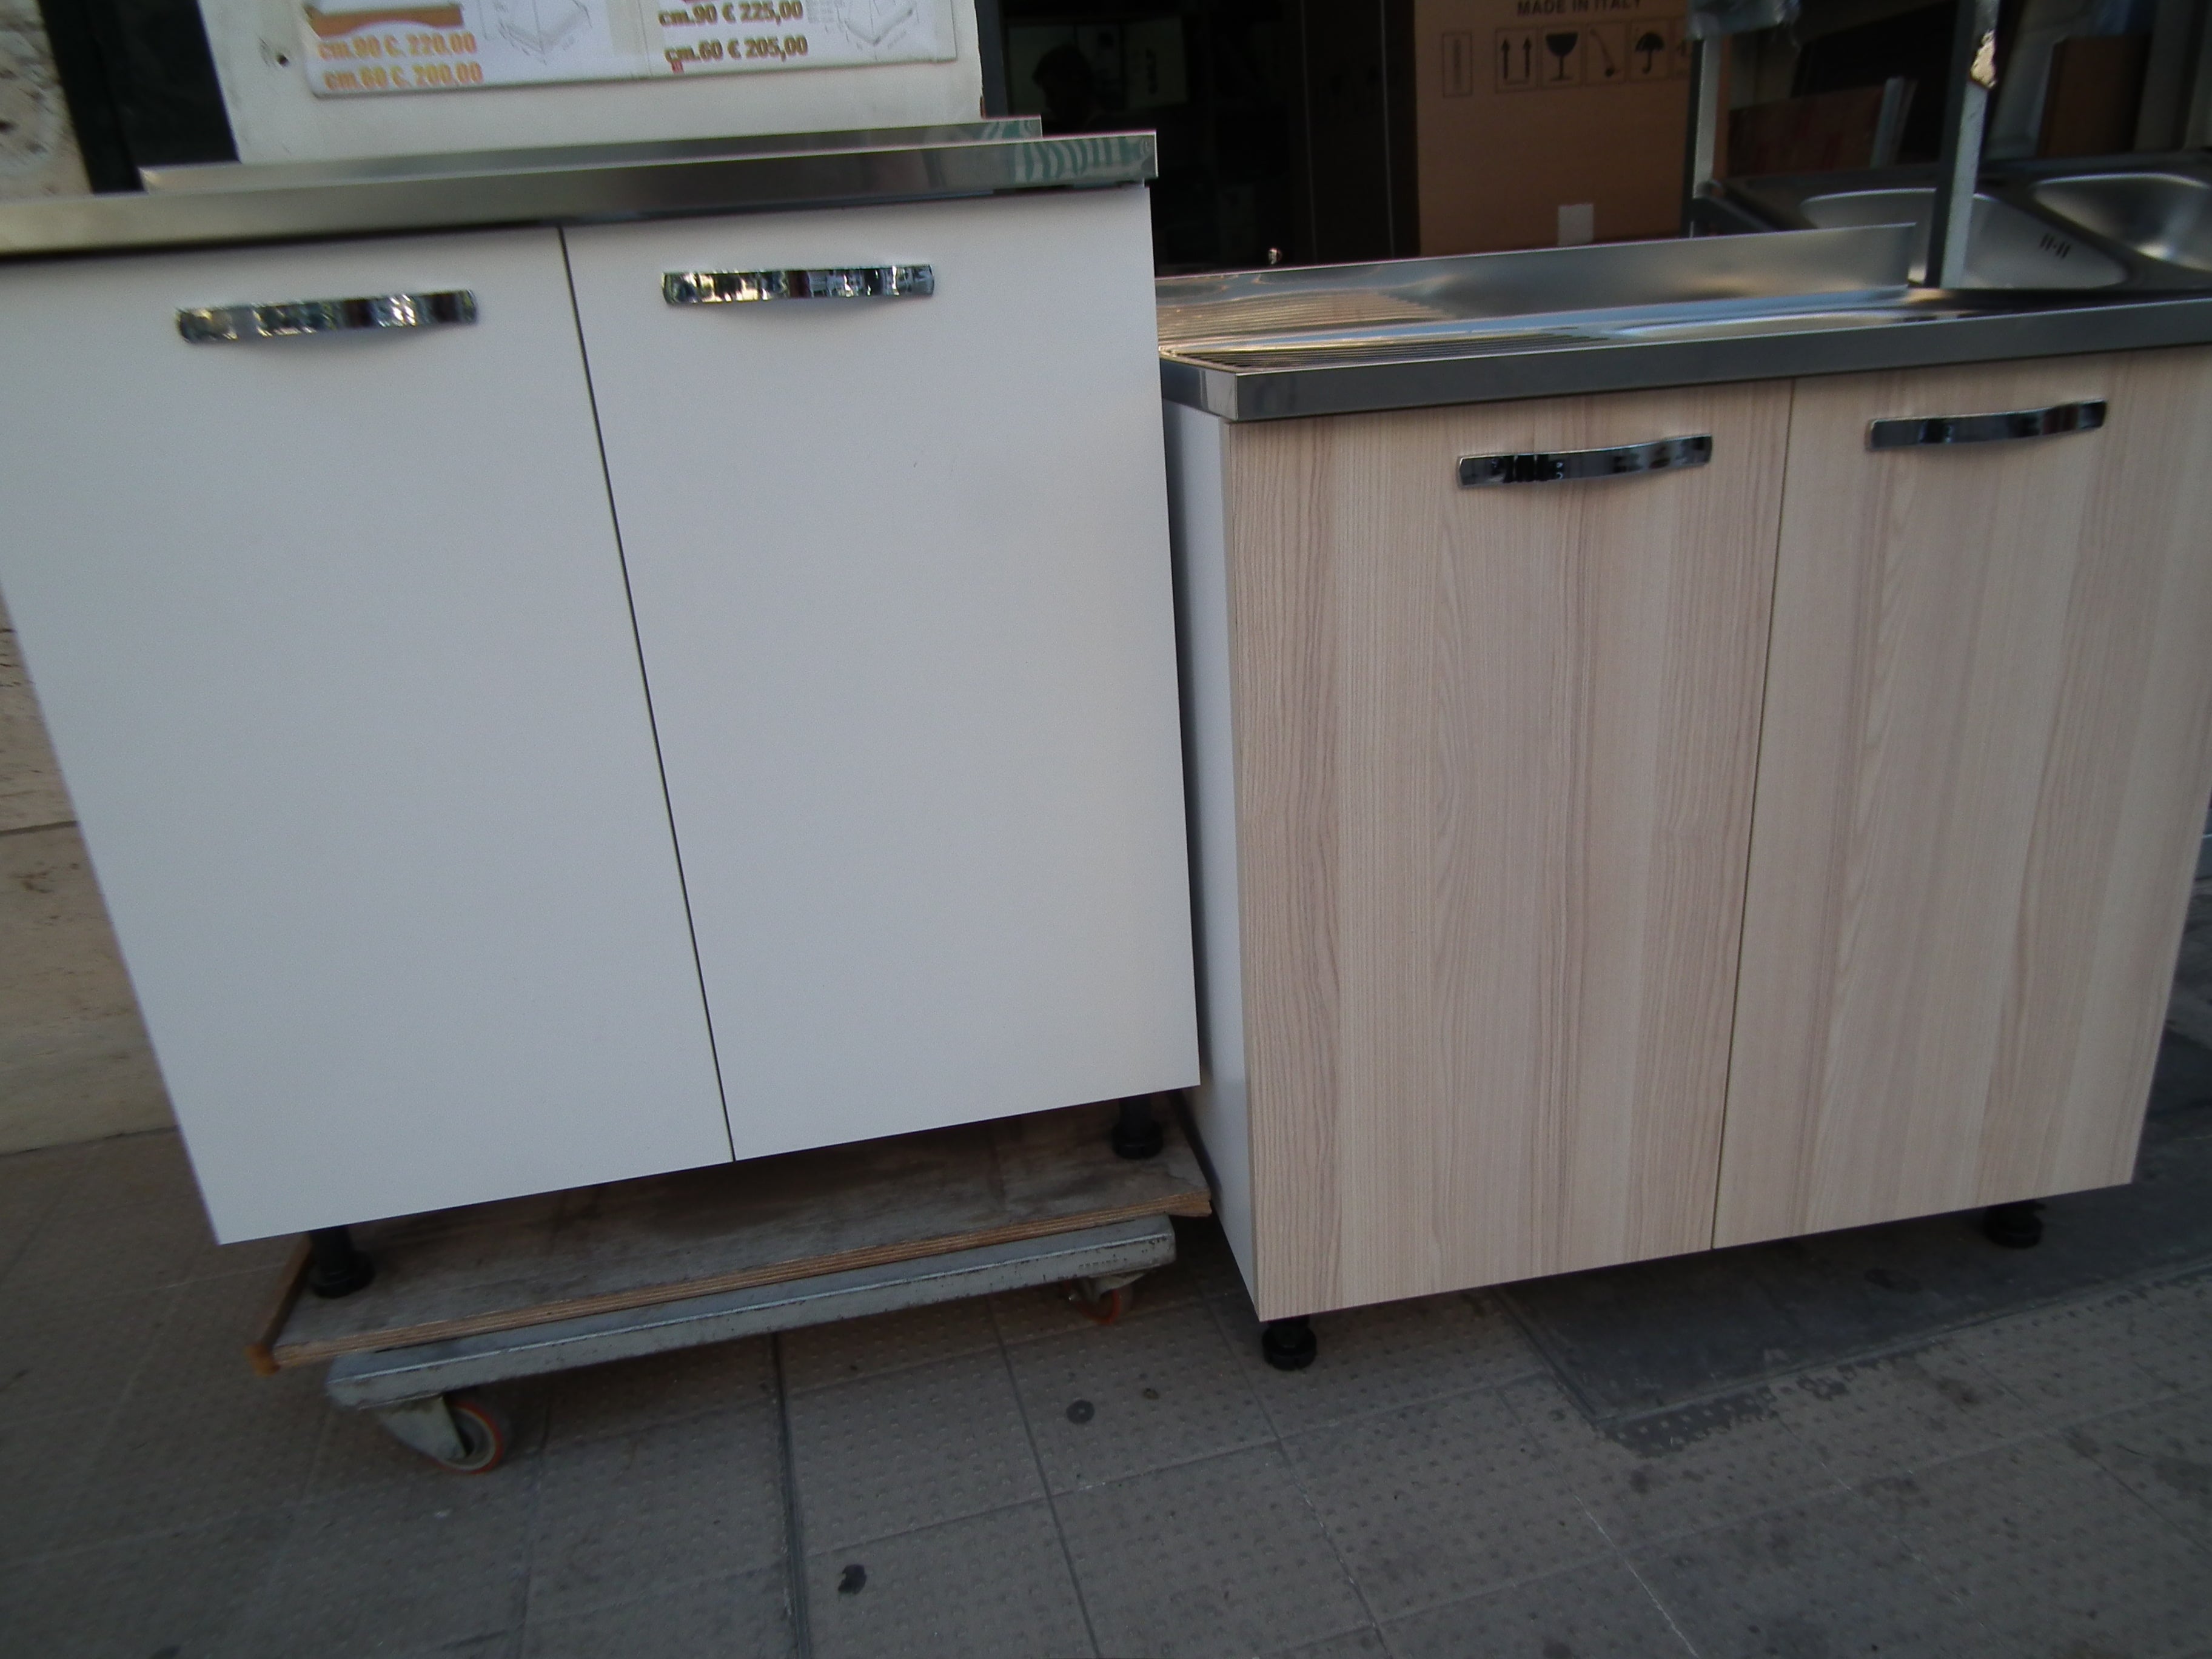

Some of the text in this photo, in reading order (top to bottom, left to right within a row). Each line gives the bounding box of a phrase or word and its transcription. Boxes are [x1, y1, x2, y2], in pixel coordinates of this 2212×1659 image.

[658, 4, 718, 27] cm.90
[738, 0, 803, 26] 225,00
[1517, 0, 1567, 16] MADE
[1572, 0, 1589, 12] IN
[663, 38, 723, 62] cm.60
[743, 34, 808, 62] 205,00
